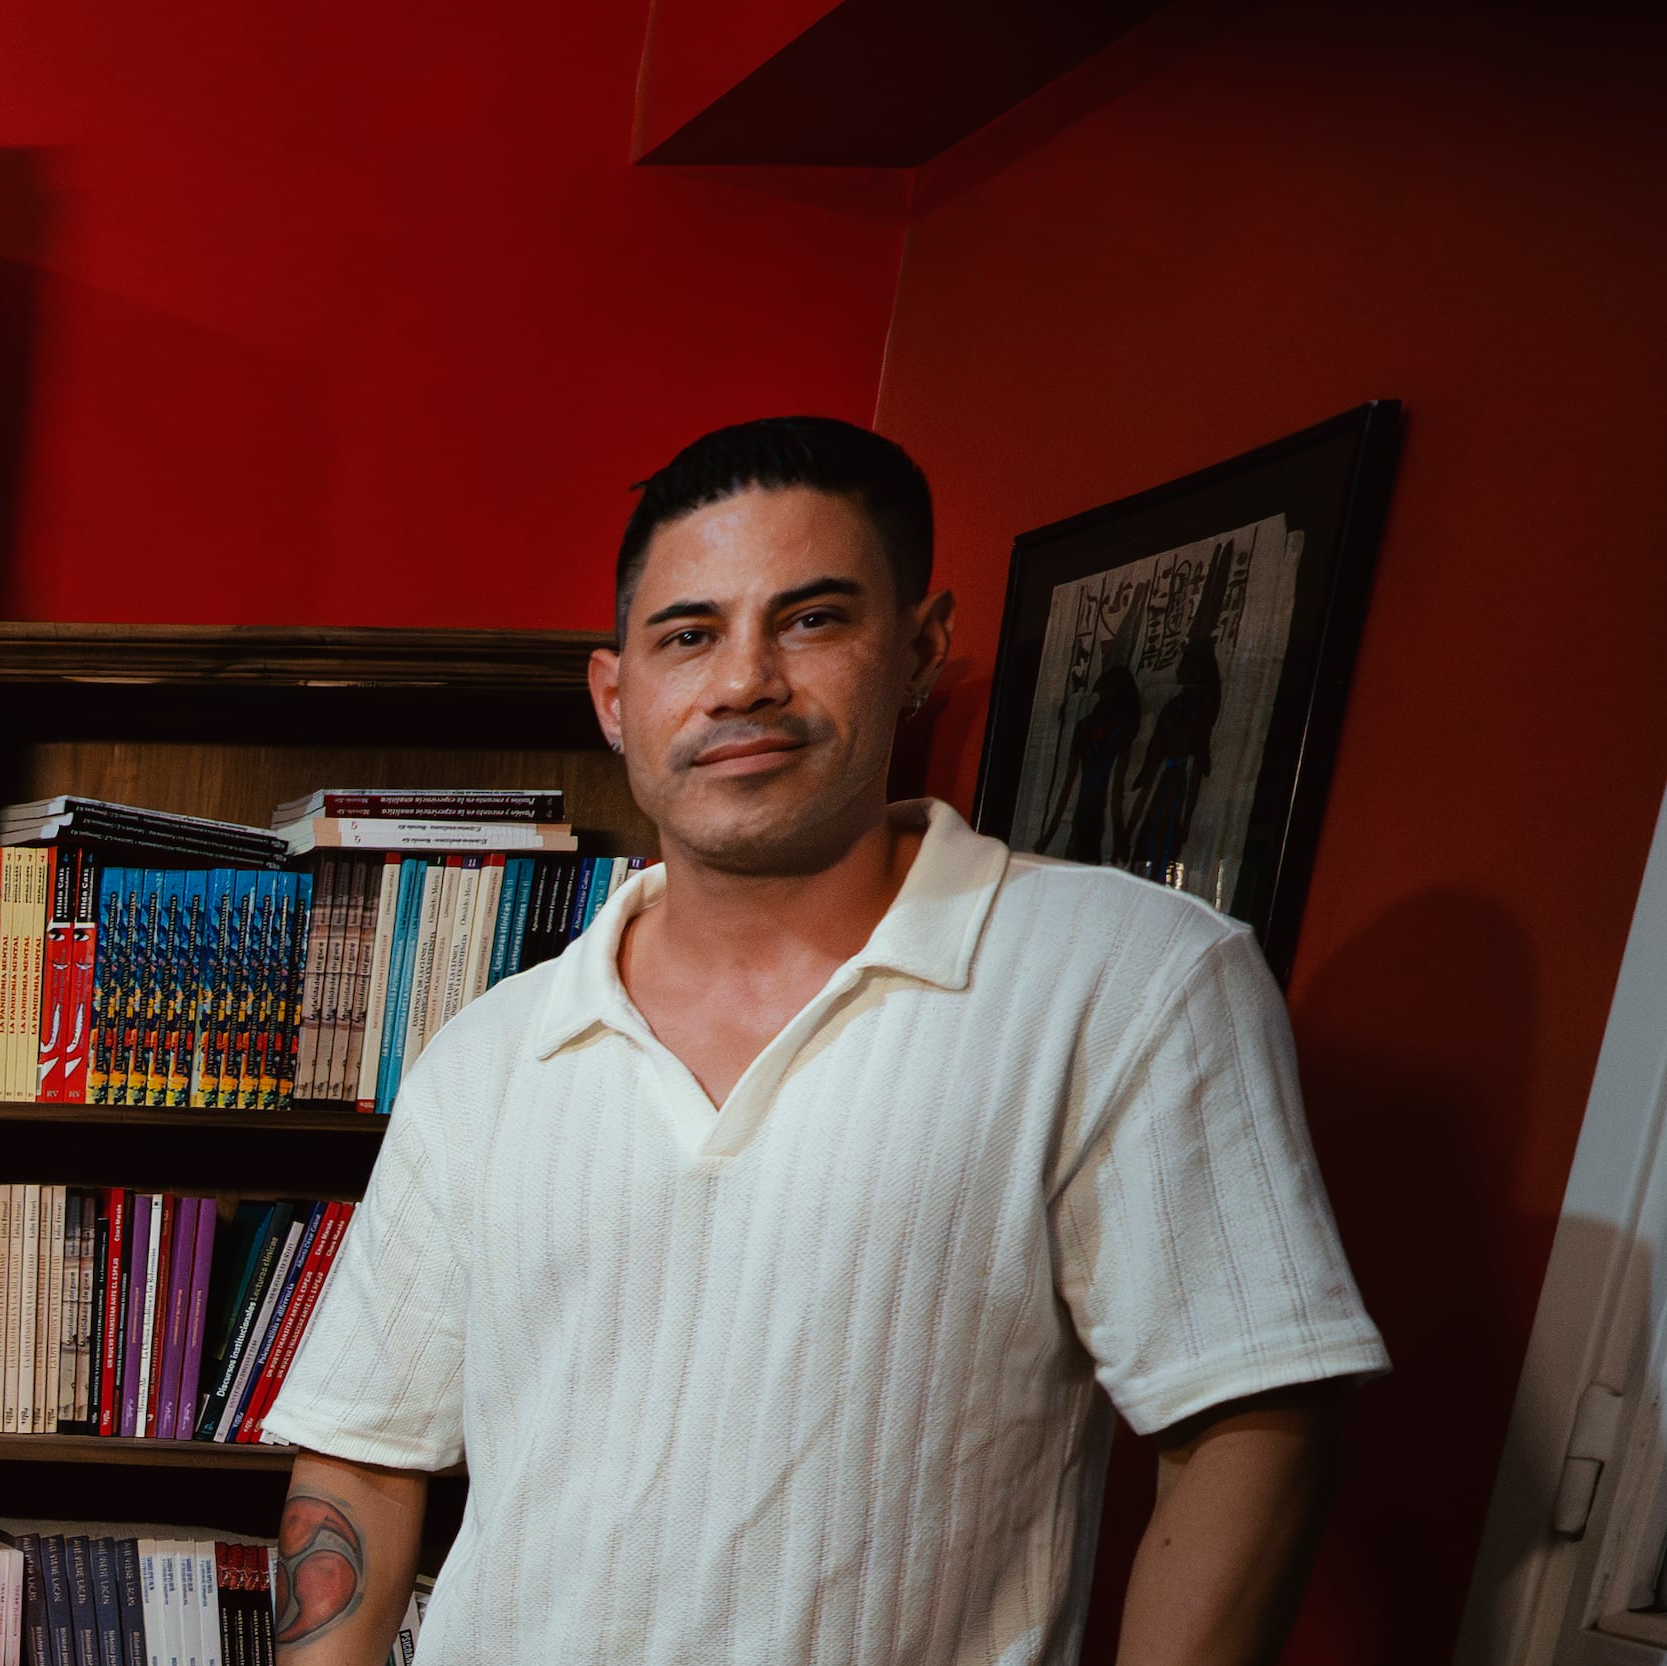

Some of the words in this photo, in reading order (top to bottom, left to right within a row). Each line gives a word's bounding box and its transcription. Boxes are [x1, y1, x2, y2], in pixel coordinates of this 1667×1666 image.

[0, 1023, 5, 1033] LA
[217, 1361, 237, 1397] Discursos
[231, 1301, 256, 1362] Institucionales
